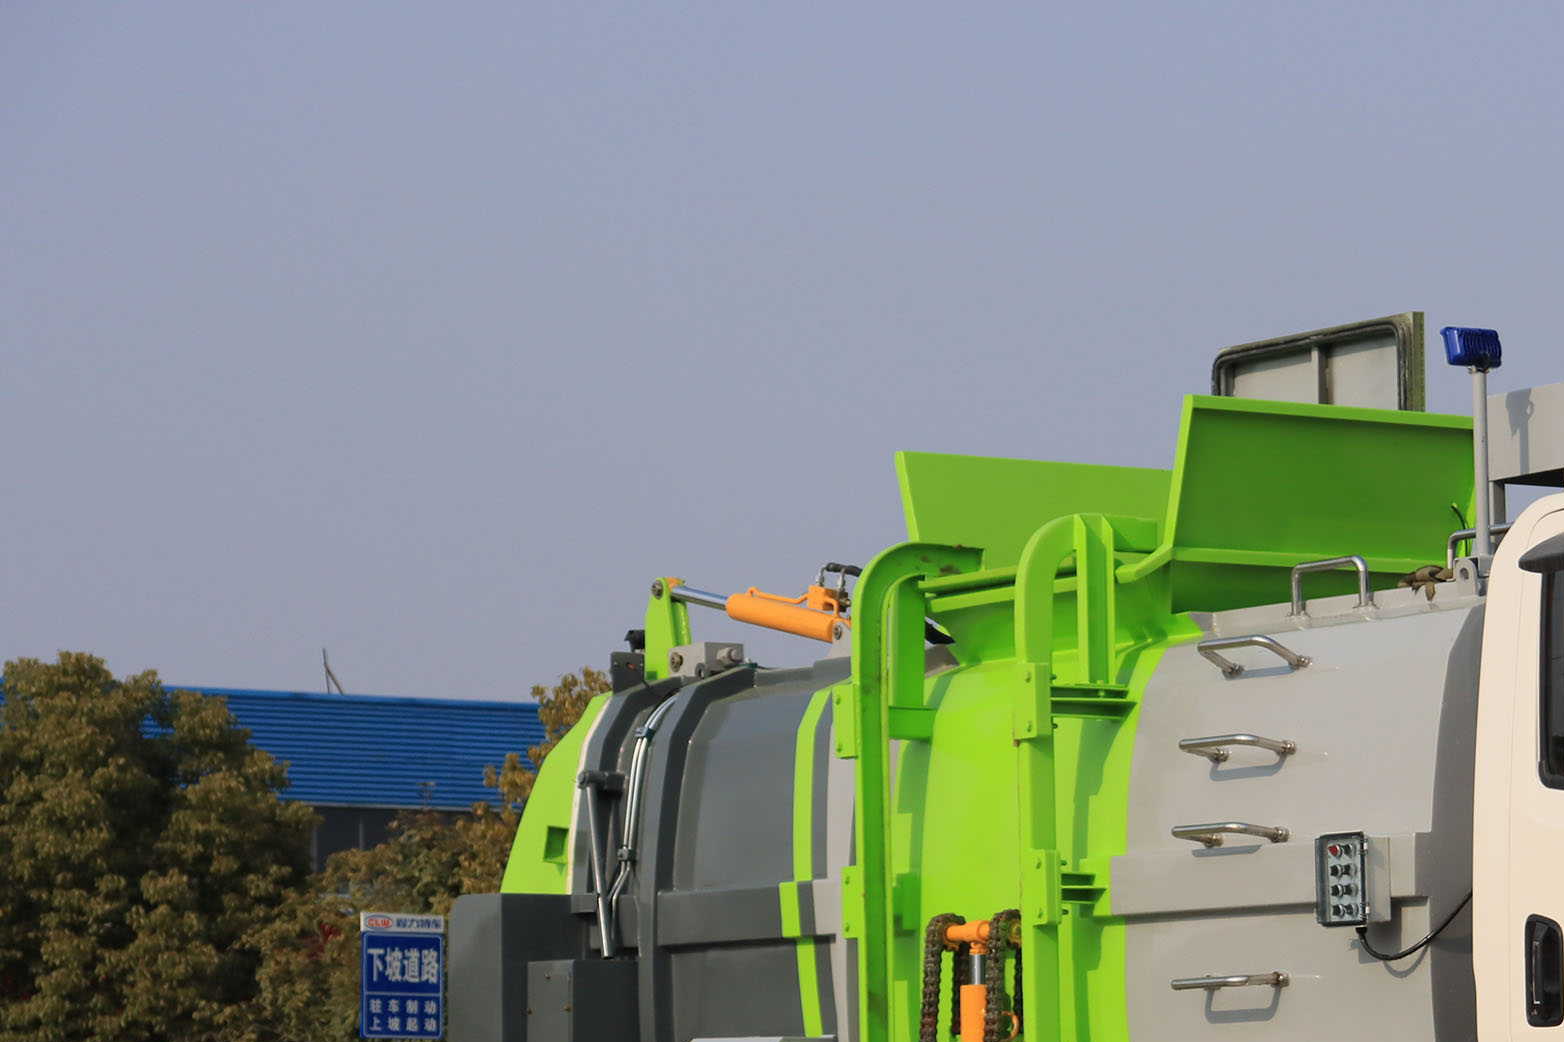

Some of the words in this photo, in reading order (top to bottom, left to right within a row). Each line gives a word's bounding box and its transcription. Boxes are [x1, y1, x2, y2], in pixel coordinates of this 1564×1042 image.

[367, 947, 438, 983] 下坡道路
[369, 998, 437, 1014] 驻车制动
[369, 1016, 437, 1031] 上坡起动
